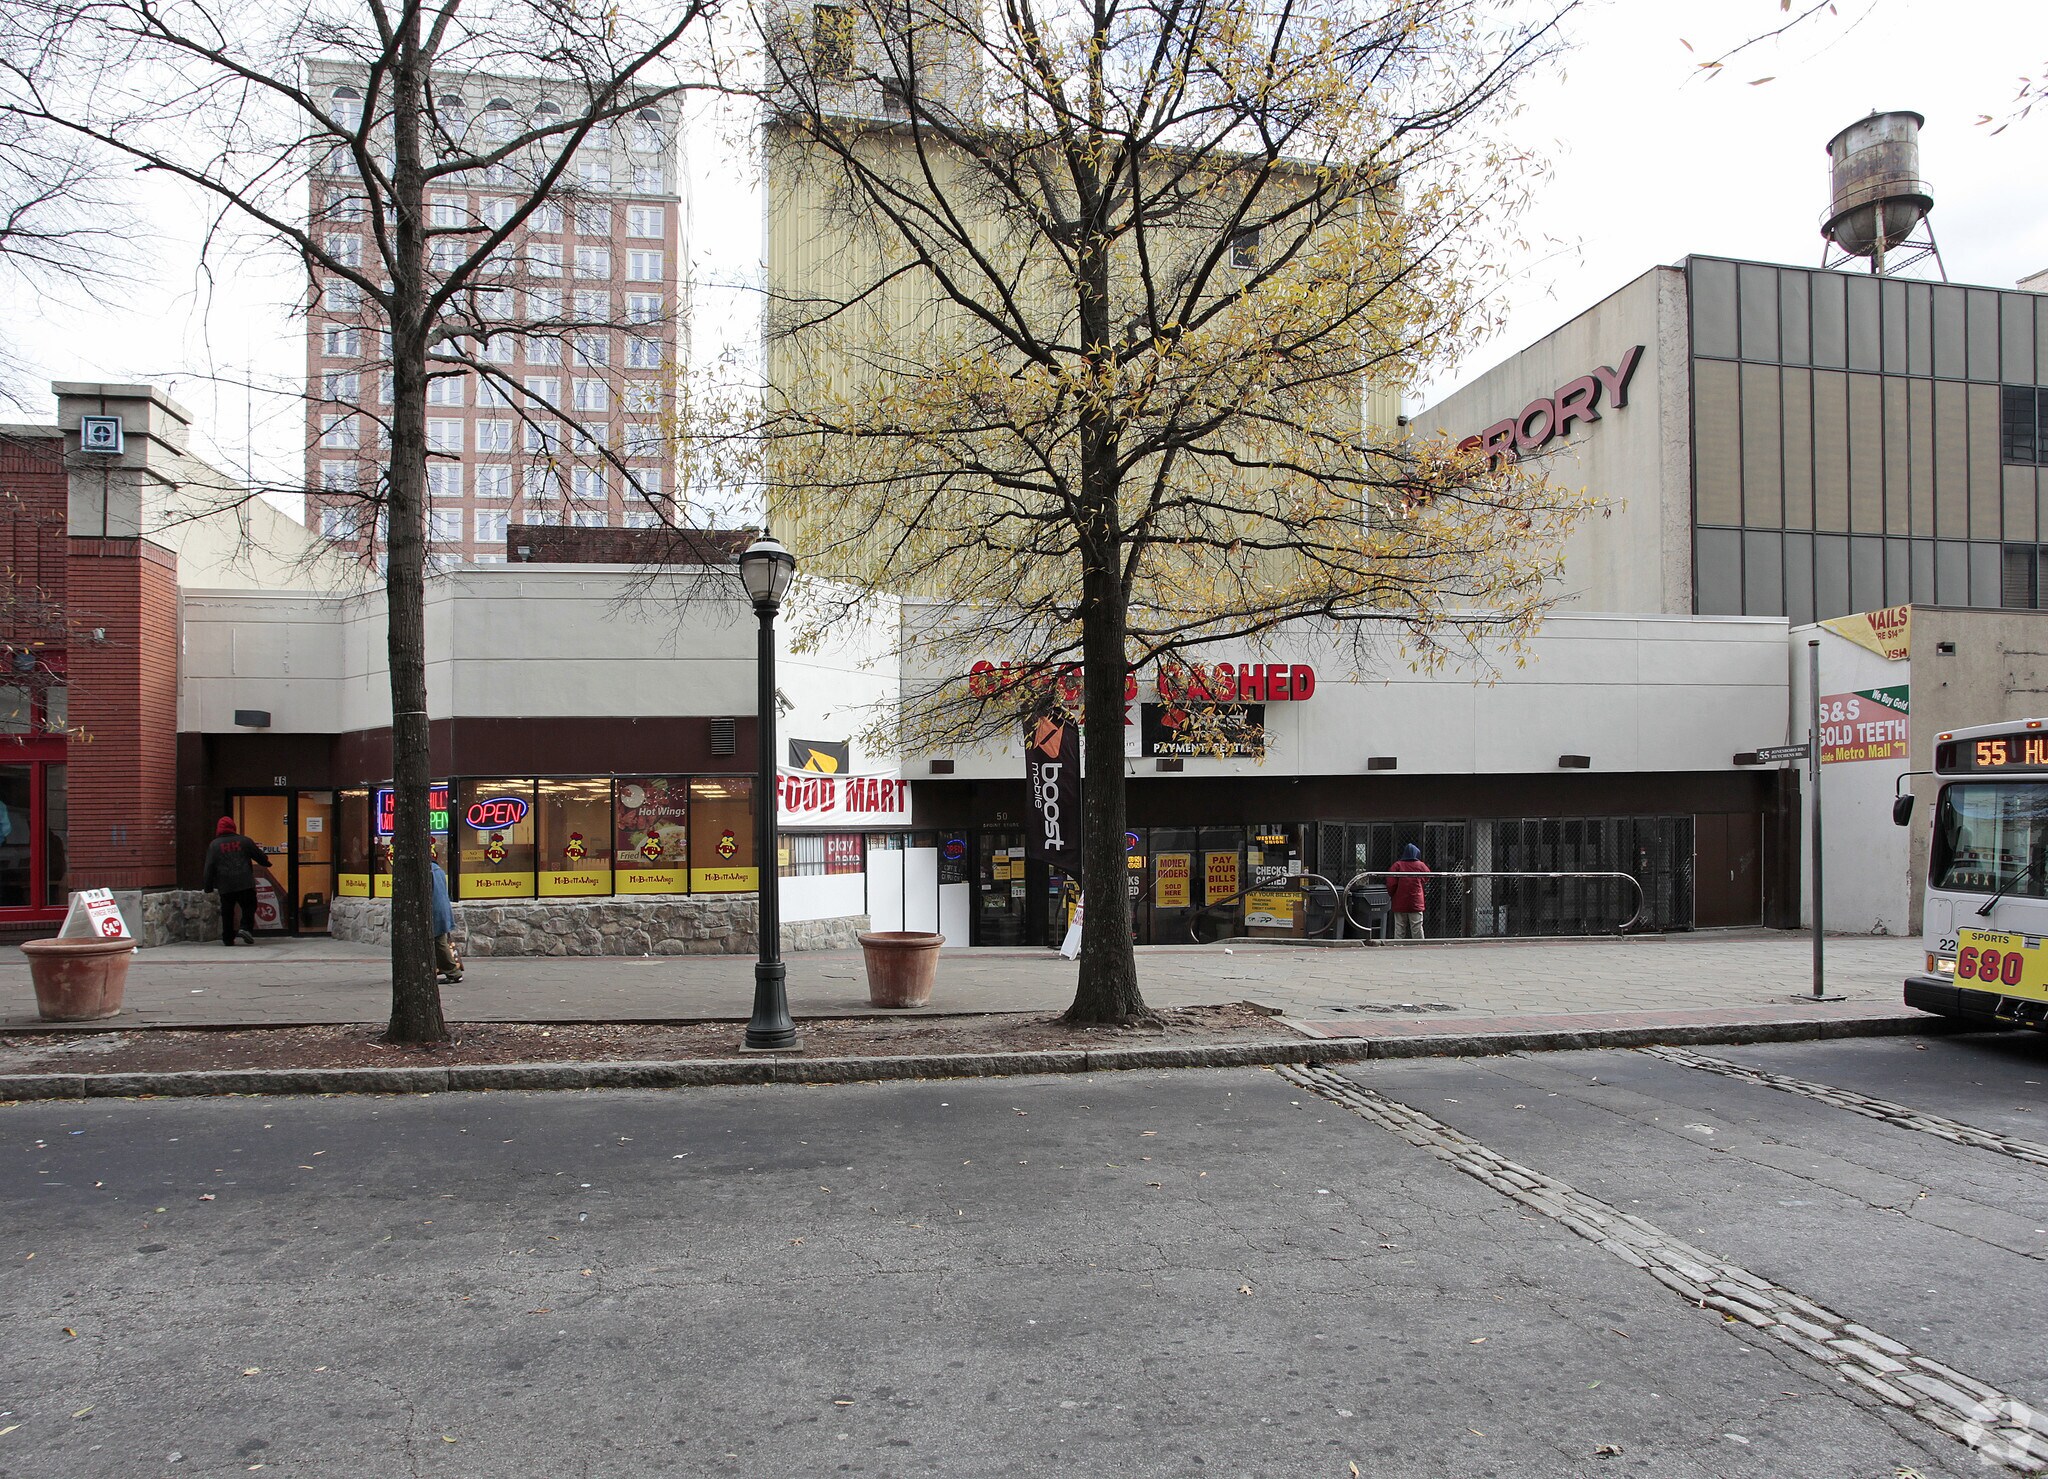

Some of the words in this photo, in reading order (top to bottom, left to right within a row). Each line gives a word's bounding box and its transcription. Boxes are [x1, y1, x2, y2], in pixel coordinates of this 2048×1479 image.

[1867, 606, 1908, 631] NAILS
[1881, 693, 1893, 707] Buy
[1893, 698, 1909, 710] Gold
[1856, 719, 1906, 743] TEETH
[1759, 751, 1770, 760] 55
[1821, 752, 1834, 762] side
[1835, 747, 1865, 761] Metro
[1868, 743, 1891, 758] Mall
[1976, 741, 2006, 767] 55
[273, 776, 287, 786] 46
[1031, 762, 1042, 809] mobile
[777, 775, 836, 813] FOOD
[846, 778, 908, 813] MART
[638, 807, 656, 816] Hot
[657, 807, 686, 818] Wings
[1041, 762, 1065, 851] boost
[430, 811, 449, 830] PEN
[467, 803, 522, 825] OPEN
[996, 812, 1008, 821] 50
[827, 837, 854, 855] play
[620, 852, 640, 860] Fried
[835, 852, 861, 866] here
[1160, 858, 1187, 868] MONEY
[1212, 856, 1232, 864] PAY
[1157, 869, 1189, 879] ORDERS
[1208, 865, 1236, 873] YOUR
[1255, 866, 1288, 876] CHECKS
[1208, 875, 1236, 883] BILLS
[1209, 885, 1236, 893] HERE
[1939, 938, 1959, 952] 22
[1971, 932, 2010, 944] SPORTS
[1957, 945, 2025, 987] 680
